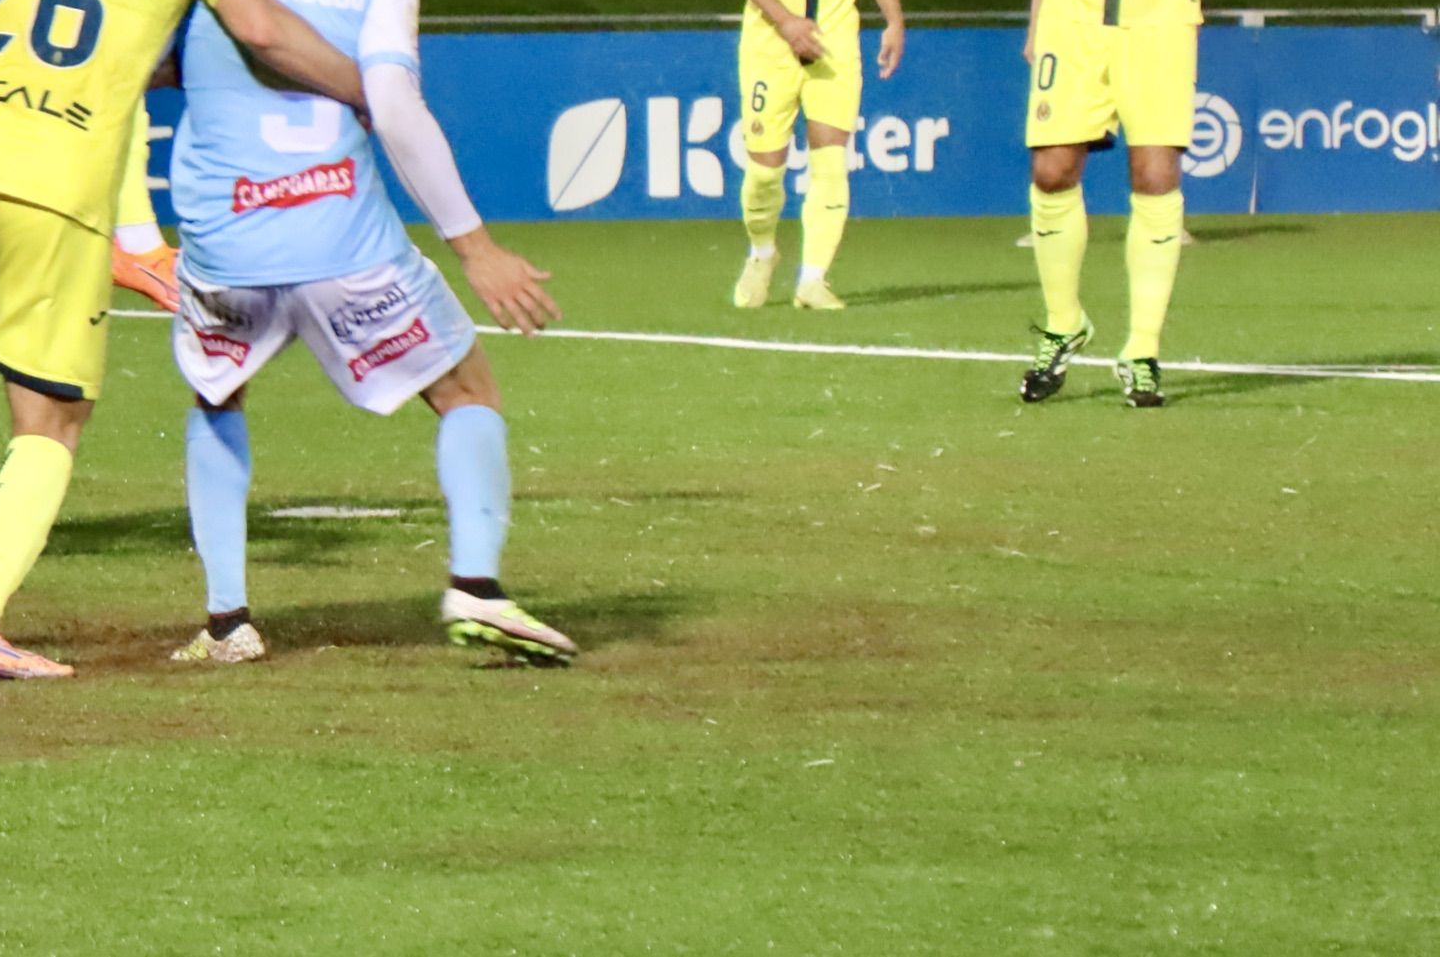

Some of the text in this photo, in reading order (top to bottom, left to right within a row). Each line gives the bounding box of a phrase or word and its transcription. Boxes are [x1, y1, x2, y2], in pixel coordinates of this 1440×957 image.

[750, 80, 768, 113] 6
[647, 96, 950, 197] Ker
[1258, 100, 1440, 162] enfogl
